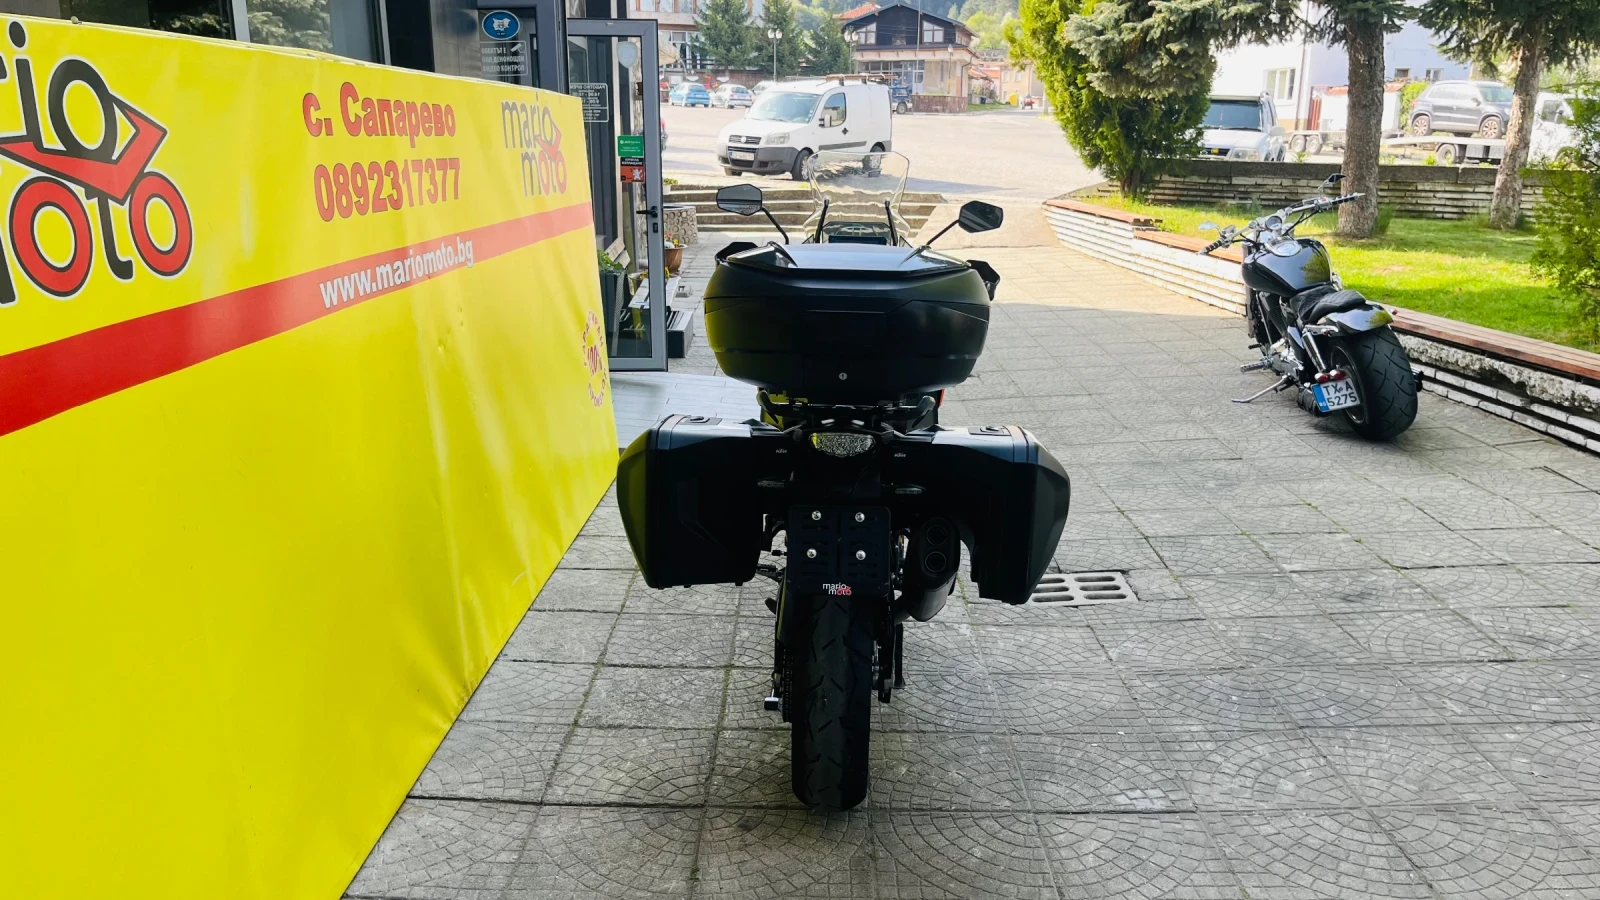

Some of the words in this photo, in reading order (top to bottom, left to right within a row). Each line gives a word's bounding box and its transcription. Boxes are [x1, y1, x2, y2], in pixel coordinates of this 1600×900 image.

[302, 93, 333, 137] с.
[340, 82, 456, 148] Сапарево
[501, 91, 554, 149] mario
[314, 158, 461, 222] 0892317377
[521, 150, 568, 197] moto
[319, 236, 474, 309] www.mariomoto.bg
[1327, 392, 1357, 407] 5275
[822, 582, 847, 590] mario
[828, 588, 852, 596] moto
